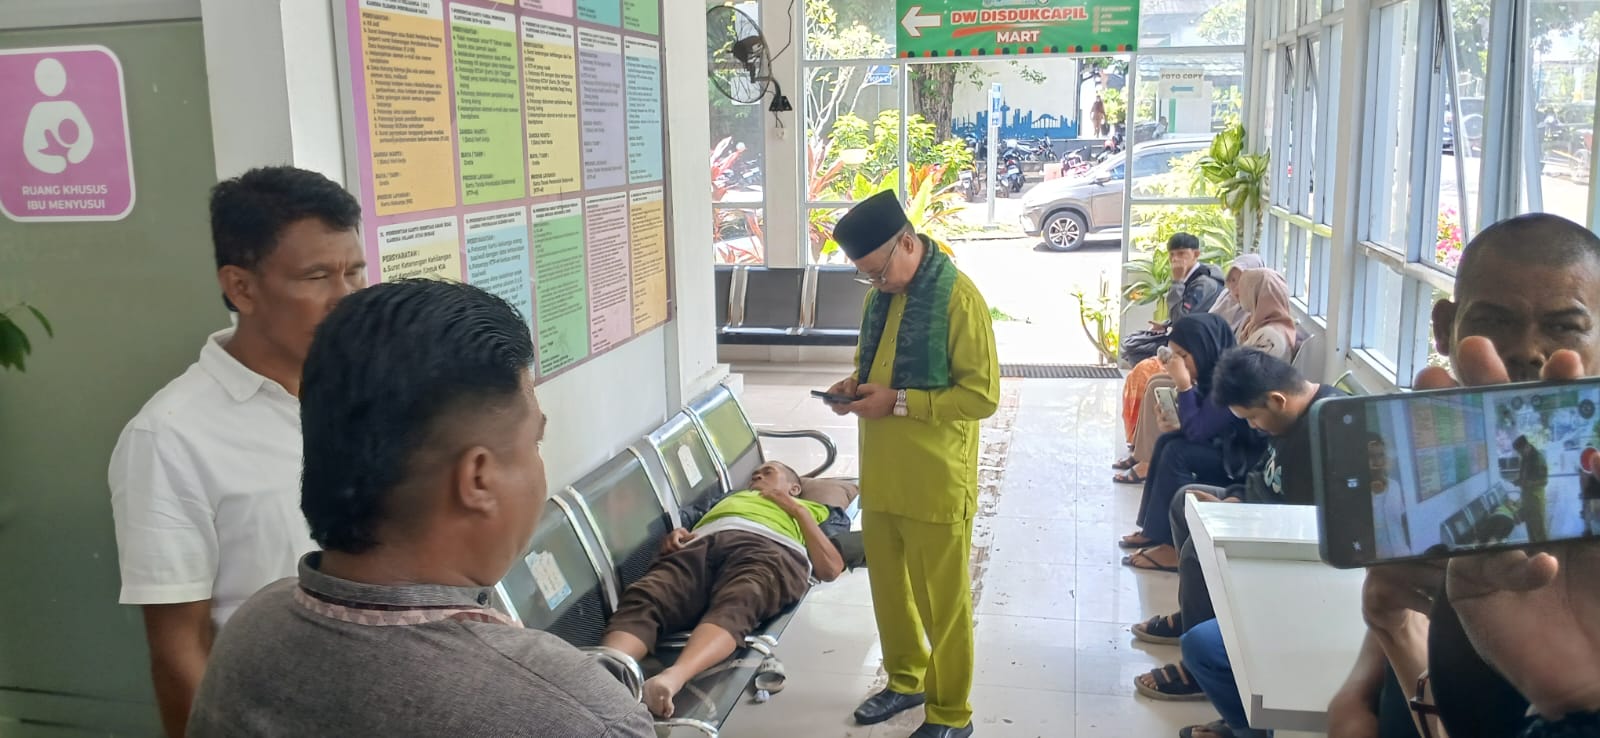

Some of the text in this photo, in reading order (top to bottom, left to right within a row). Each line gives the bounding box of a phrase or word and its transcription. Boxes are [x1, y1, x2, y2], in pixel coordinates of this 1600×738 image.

[951, 7, 1088, 24] DW DISDUKCAPIL
[996, 30, 1040, 43] MART
[22, 184, 108, 196] RUANG KHUSUS
[28, 199, 105, 210] IBU MENYUSUI
